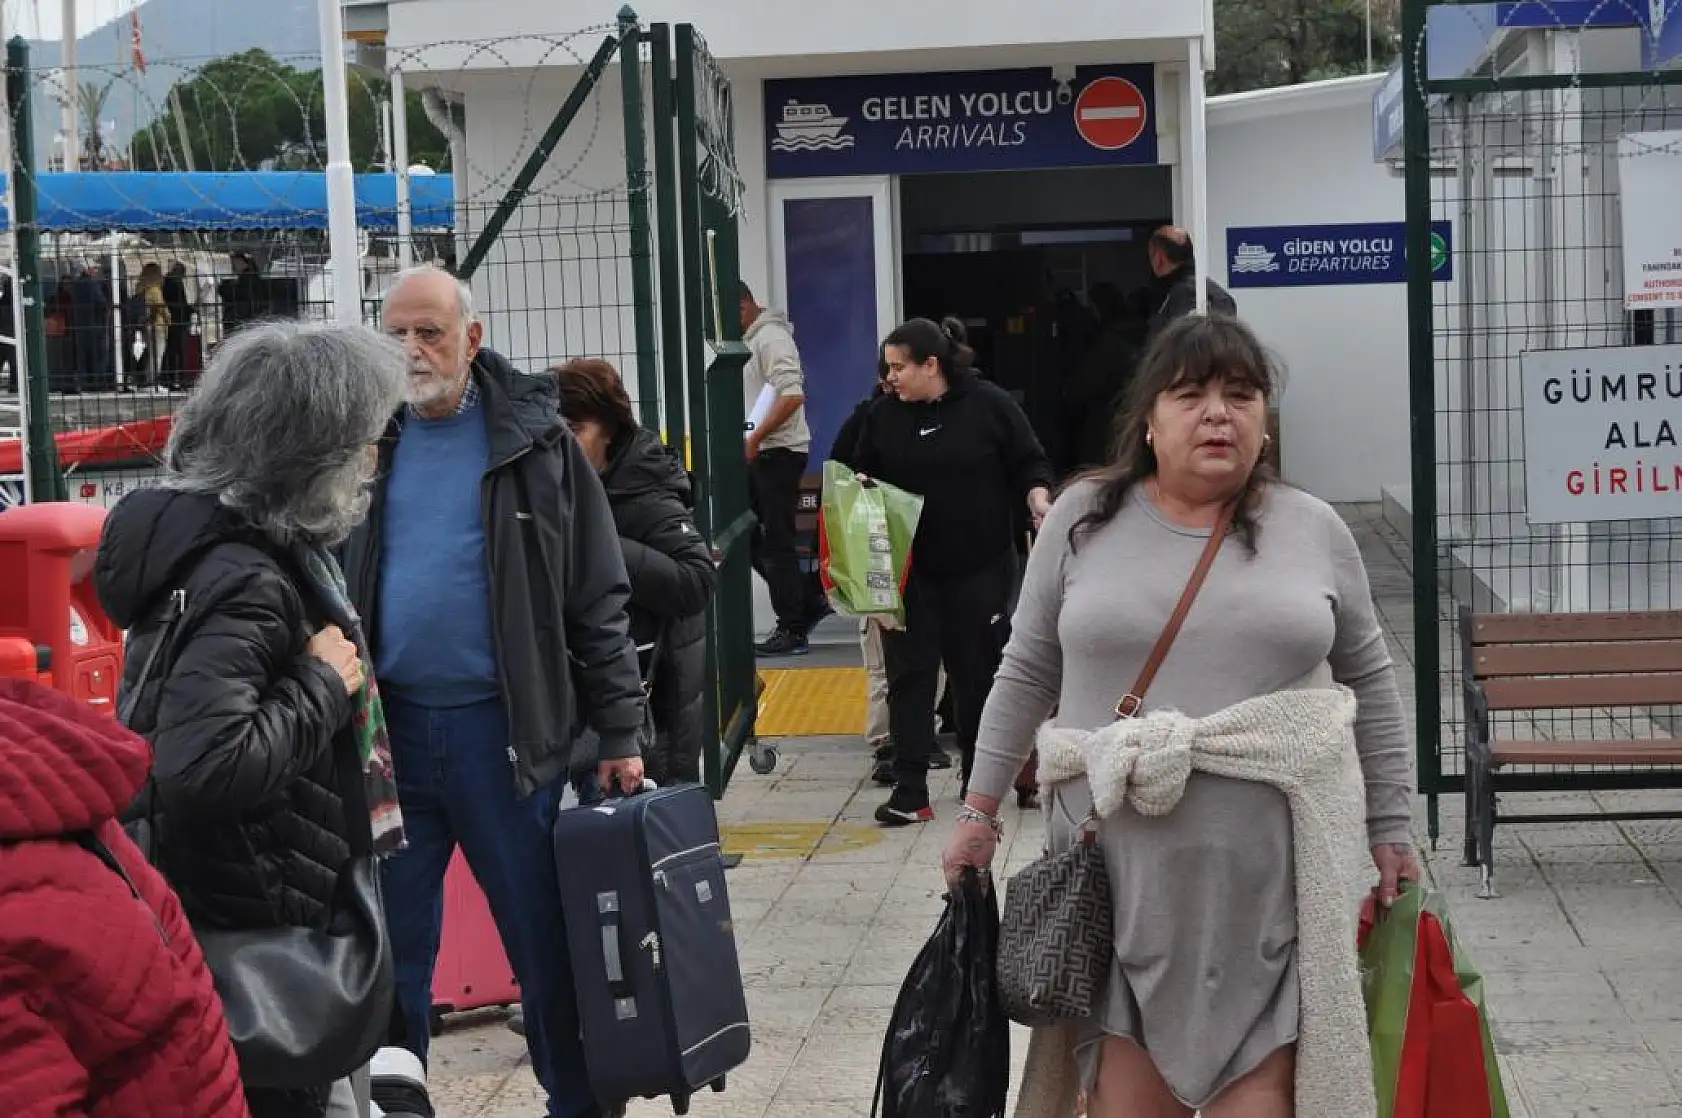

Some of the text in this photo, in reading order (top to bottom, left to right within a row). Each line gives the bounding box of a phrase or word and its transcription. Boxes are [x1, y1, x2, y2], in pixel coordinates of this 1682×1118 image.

[862, 90, 1052, 121] GELEN YOLCU
[895, 121, 1027, 150] ARRIVALS
[1283, 237, 1393, 256] GİDEN YOLCU
[1288, 255, 1391, 273] DEPARTURES
[1604, 418, 1678, 449] ALA
